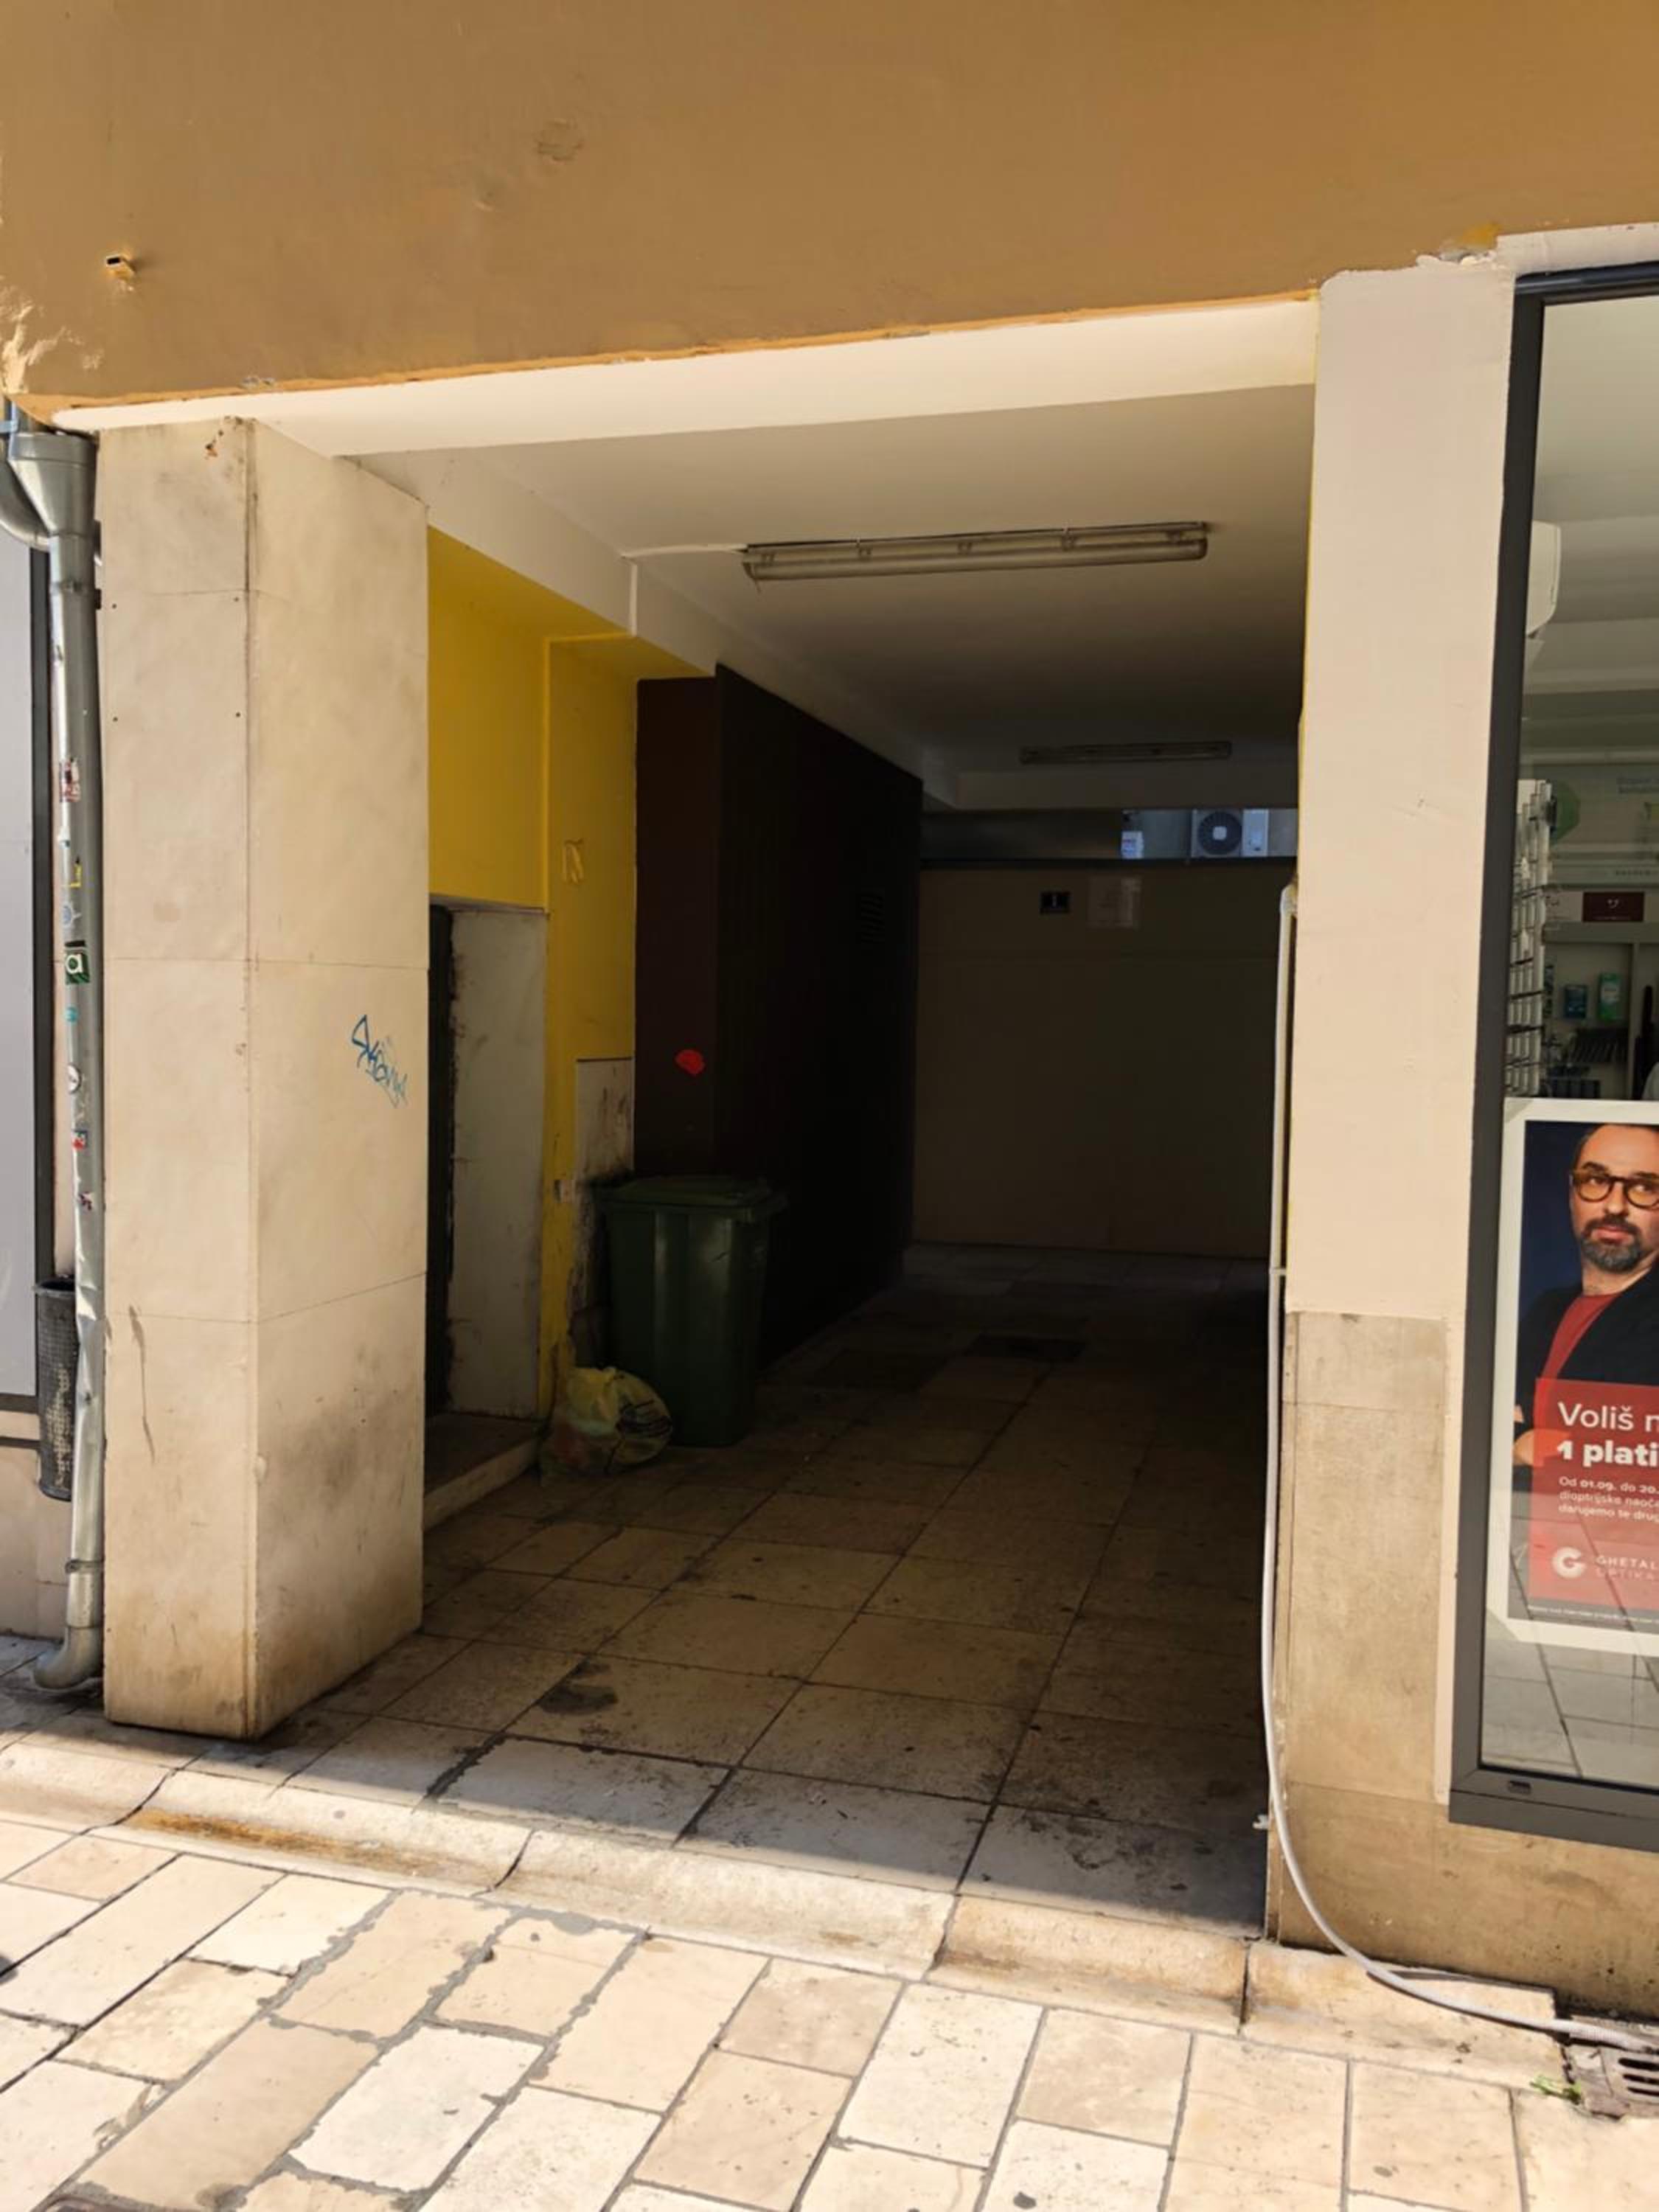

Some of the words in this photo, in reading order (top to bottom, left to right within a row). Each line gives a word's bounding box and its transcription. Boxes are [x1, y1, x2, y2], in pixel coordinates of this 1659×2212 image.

[1557, 1401, 1634, 1430] Voliš
[1557, 1440, 1573, 1460] 1
[1583, 1439, 1658, 1467] plati
[1559, 1476, 1577, 1487] Od
[1580, 1480, 1616, 1492] 01.09.
[1620, 1482, 1636, 1492] do
